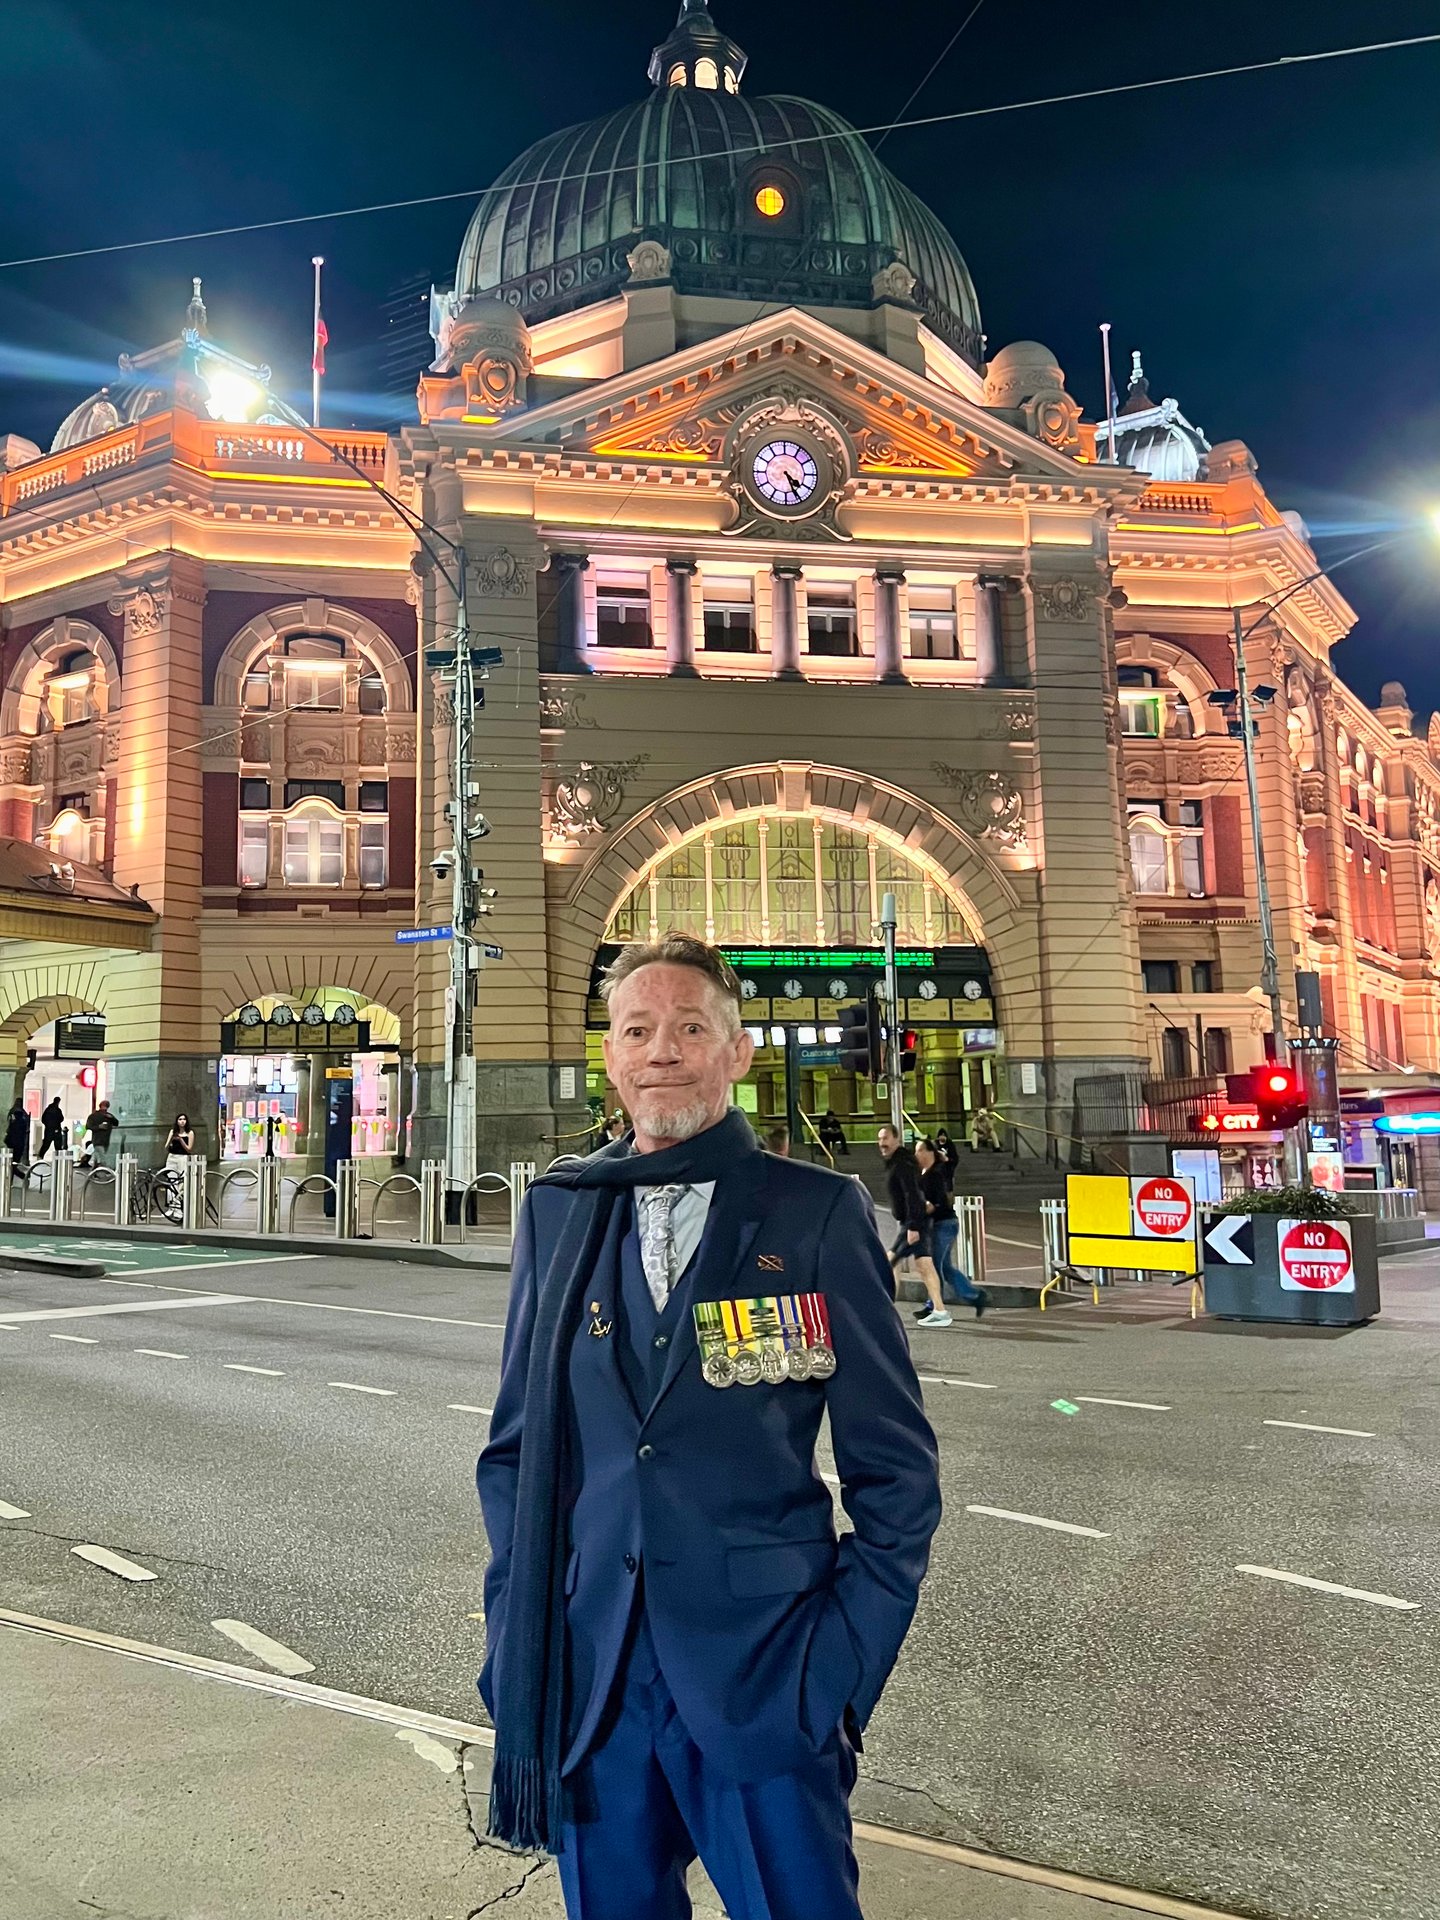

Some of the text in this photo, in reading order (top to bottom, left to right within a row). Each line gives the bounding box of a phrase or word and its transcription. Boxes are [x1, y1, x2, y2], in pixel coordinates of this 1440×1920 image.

[397, 930, 429, 940] Swanston
[430, 928, 438, 937] St
[801, 1049, 834, 1058] Customer
[1222, 1114, 1260, 1130] CITY
[1154, 1187, 1173, 1200] NO
[1145, 1213, 1184, 1227] ENTRY
[1303, 1232, 1325, 1247] NO
[1291, 1264, 1341, 1280] ENTRY
